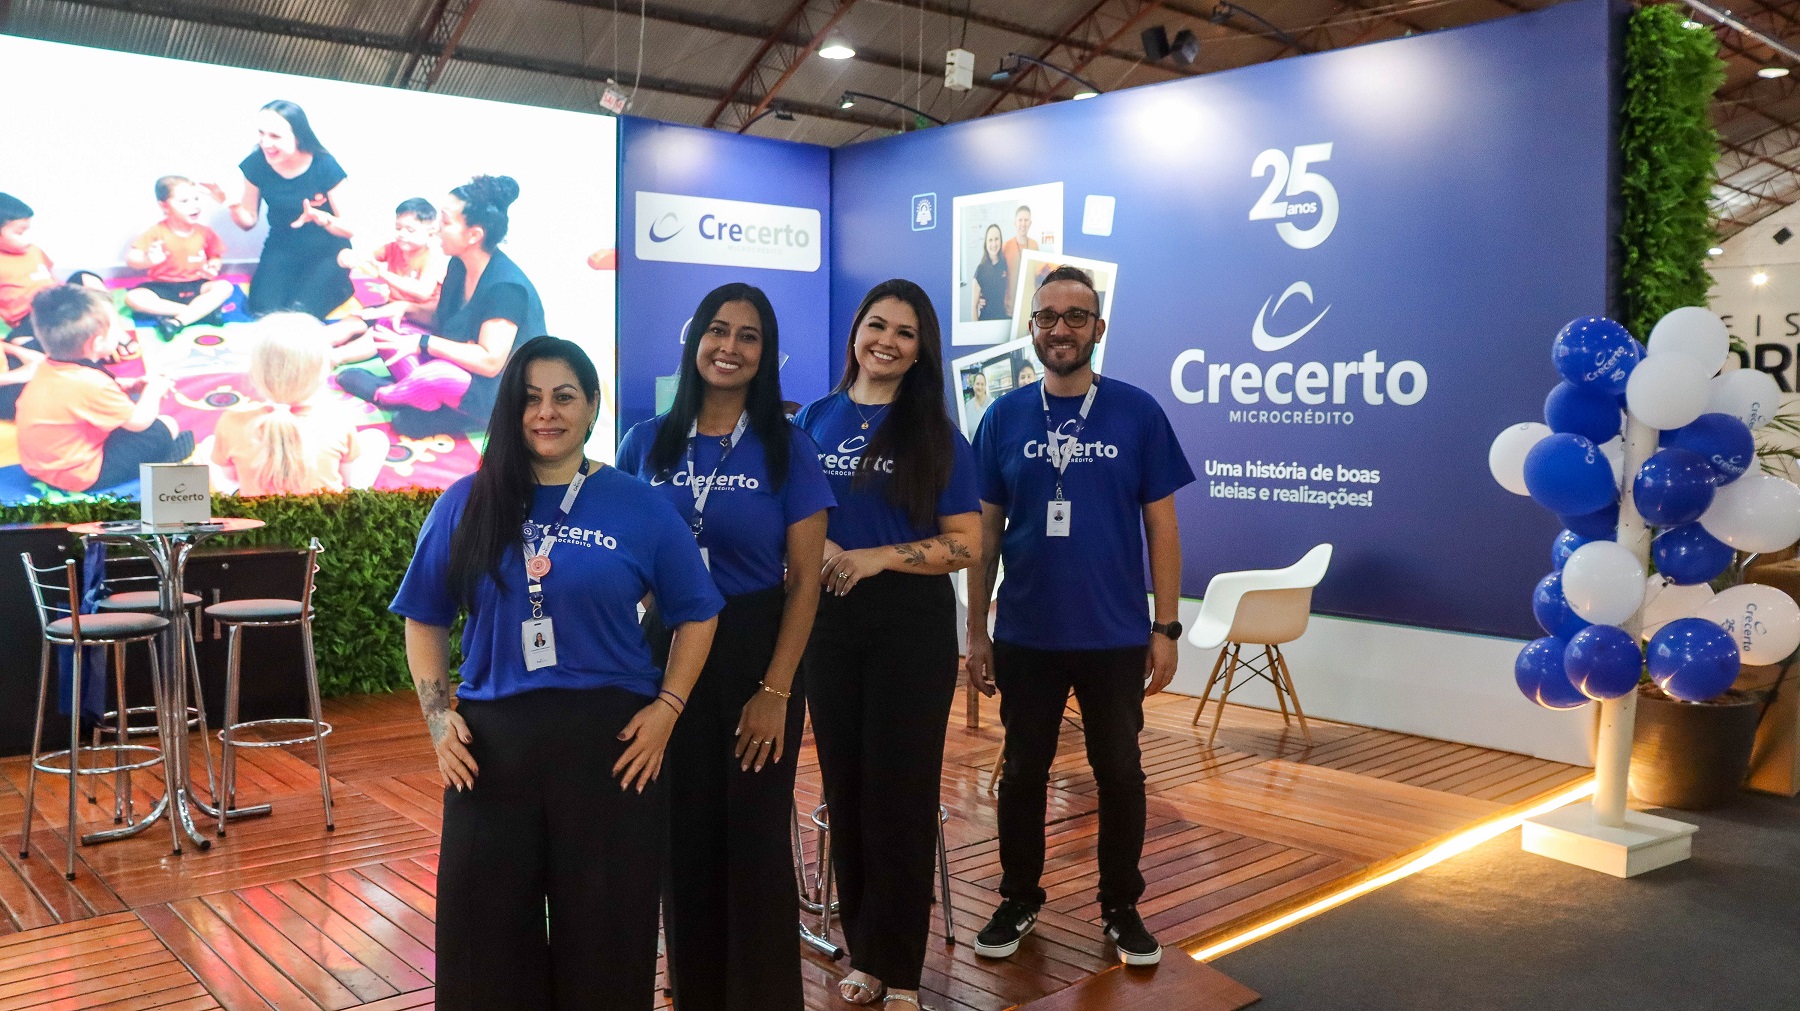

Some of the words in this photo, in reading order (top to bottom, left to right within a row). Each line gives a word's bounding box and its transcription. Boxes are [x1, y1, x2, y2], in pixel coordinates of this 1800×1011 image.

[1249, 142, 1340, 250] 25
[1287, 202, 1317, 216] anos
[698, 214, 810, 248] Crecerto
[1170, 348, 1428, 406] Crecerto
[1229, 409, 1355, 425] MICROCRÉDITO
[1205, 460, 1243, 477] Uma
[1246, 461, 1307, 481] história
[1311, 464, 1333, 482] de
[1336, 465, 1380, 484] boas
[158, 493, 204, 502] Crecerto
[1210, 481, 1256, 499] ideias
[1259, 488, 1270, 501] e
[1273, 486, 1373, 510] realizações!
[1743, 603, 1757, 652] Crecerto
